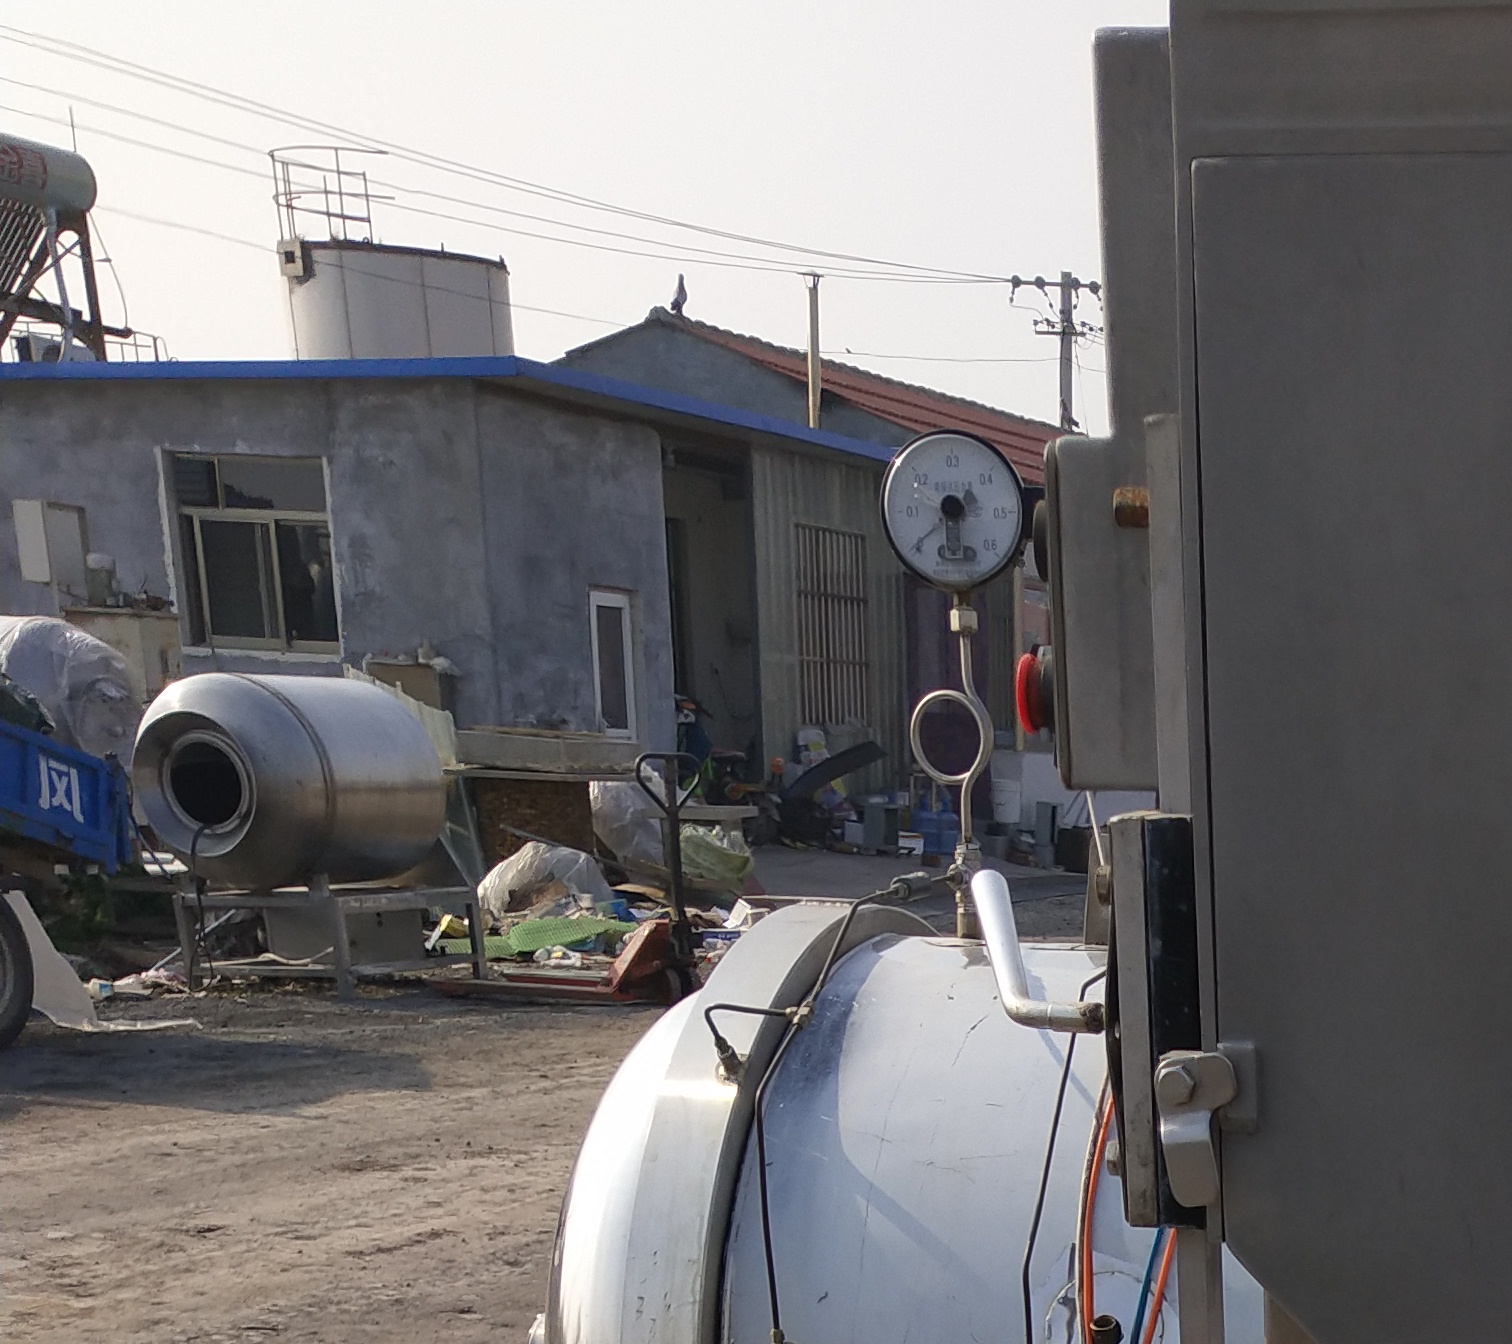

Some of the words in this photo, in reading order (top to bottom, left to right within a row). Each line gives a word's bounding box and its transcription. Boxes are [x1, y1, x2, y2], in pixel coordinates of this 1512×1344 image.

[946, 454, 960, 468] 0.3
[914, 473, 928, 486] 0.2
[979, 473, 993, 486] 0.4
[906, 505, 919, 518] 0.1
[993, 506, 1007, 519] 0.5
[983, 539, 998, 552] 0.6
[38, 753, 85, 824] 风
